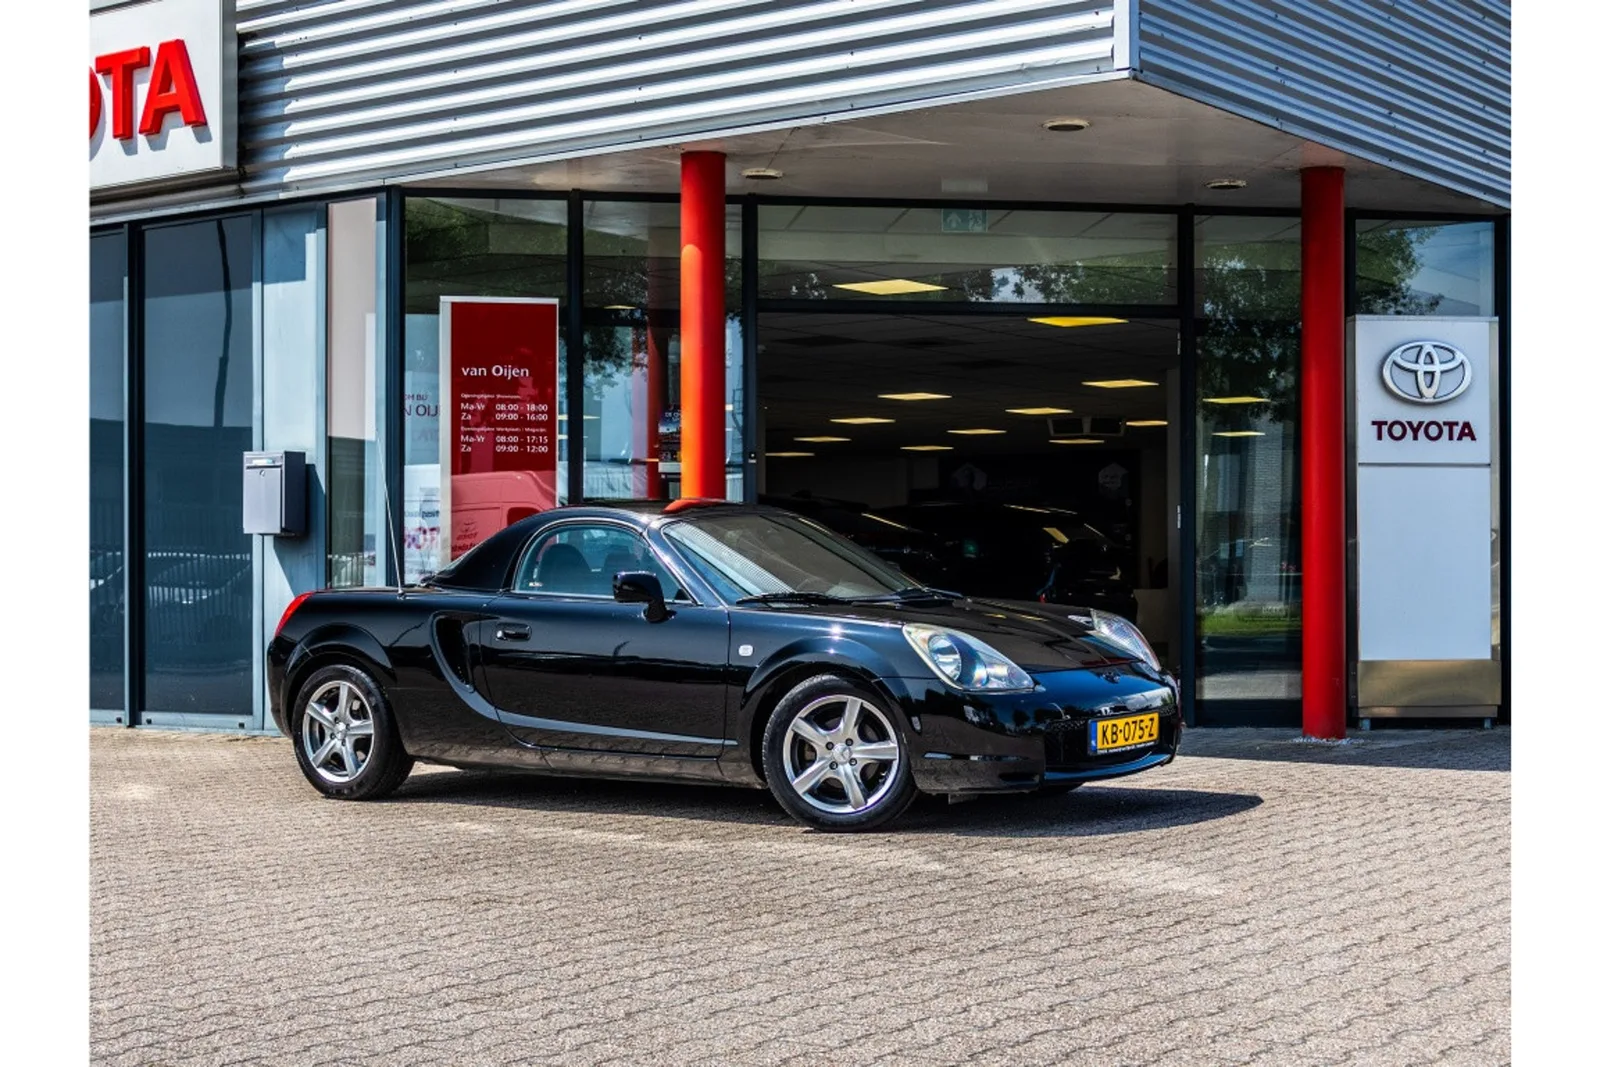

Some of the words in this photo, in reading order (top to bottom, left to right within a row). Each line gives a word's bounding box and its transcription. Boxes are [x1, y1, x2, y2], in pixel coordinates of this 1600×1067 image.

[461, 367, 487, 376] van
[491, 365, 529, 380] Oijen
[415, 404, 440, 417] OIJ
[460, 402, 485, 412] Ma-Vr
[495, 403, 519, 412] 08:00
[526, 403, 548, 412] 18:00
[461, 412, 472, 421] Za
[495, 413, 519, 422] 09:00
[526, 413, 548, 422] 16:00
[1371, 420, 1477, 442] TOYOTA
[460, 434, 485, 443] Ma-Vr
[495, 435, 519, 443] 08:00
[526, 435, 548, 444] 17:15
[461, 444, 472, 453] Za
[495, 445, 519, 453] 09:00
[526, 445, 548, 454] 12:00
[1101, 717, 1155, 745] KB-075-Z
